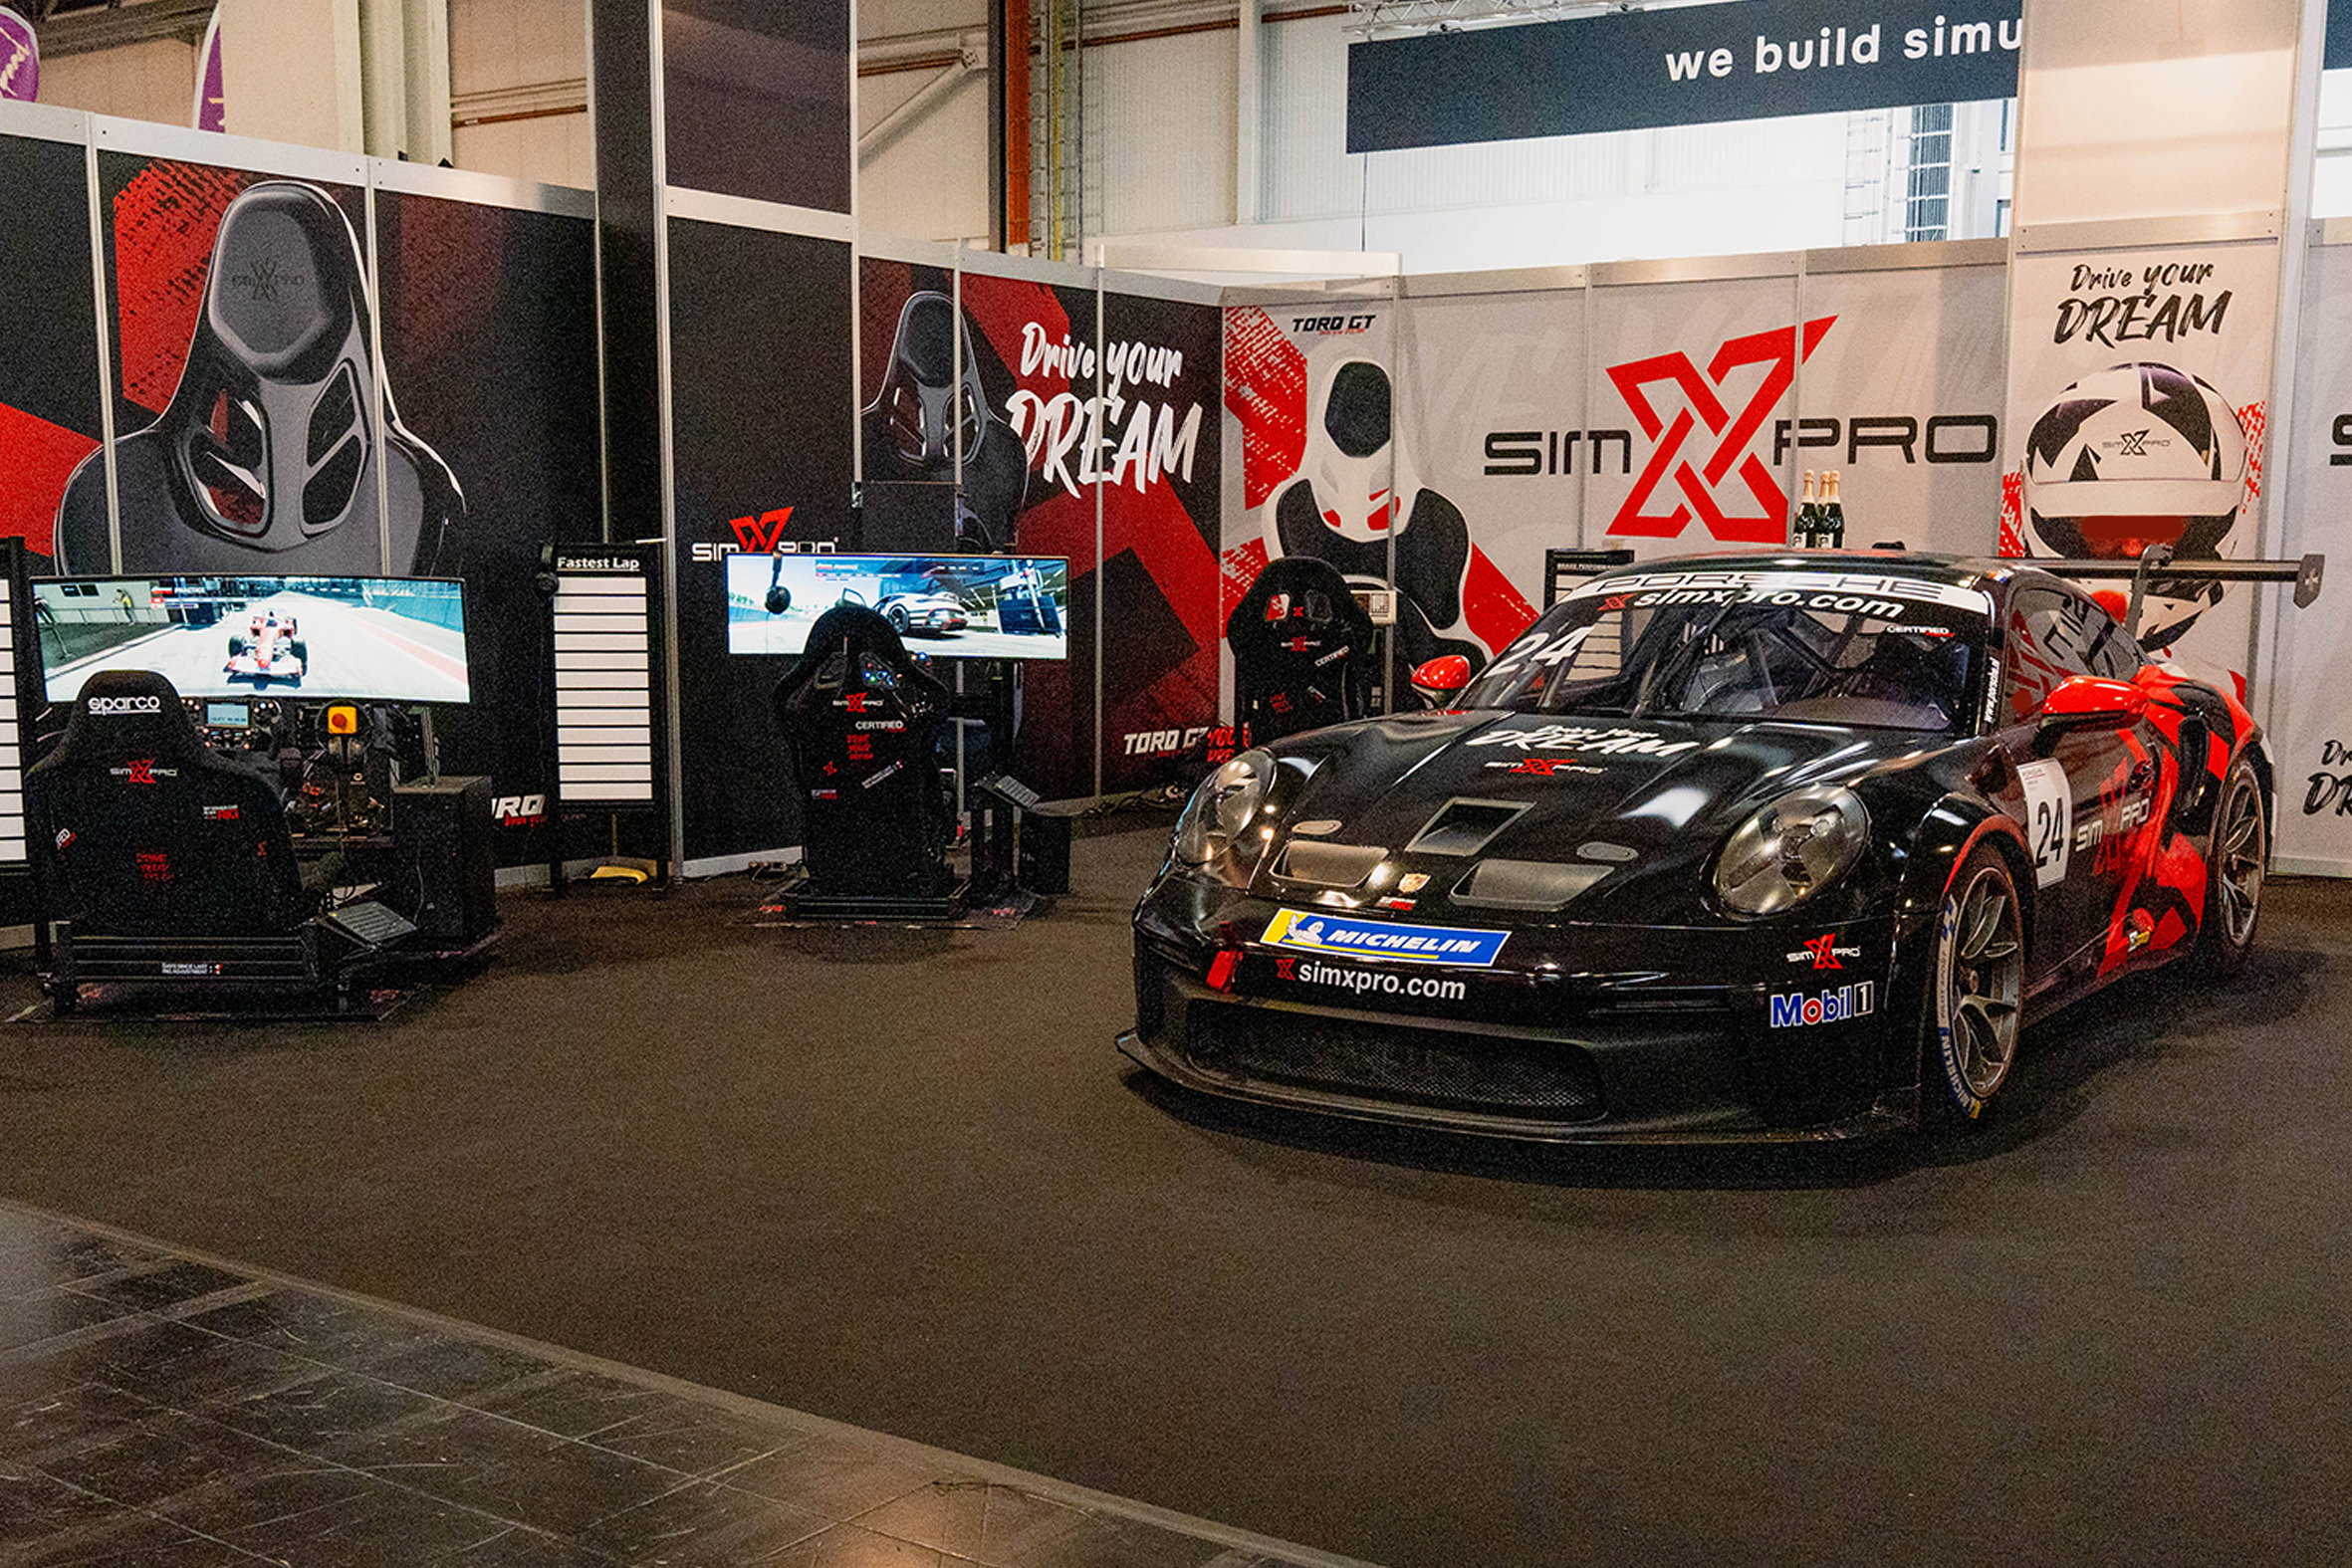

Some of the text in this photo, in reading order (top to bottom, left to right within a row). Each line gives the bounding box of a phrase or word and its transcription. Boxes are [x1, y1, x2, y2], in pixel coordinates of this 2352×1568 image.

[1666, 46, 1735, 82] we
[1755, 23, 1880, 75] build
[2070, 261, 2216, 296] Drive your
[1348, 315, 1377, 330] GT
[2053, 290, 2234, 349] DREAM
[1020, 321, 1184, 400] Drive your
[1005, 389, 1203, 499] DREAM
[558, 556, 640, 572] Fastest Lap
[1633, 587, 1907, 618] simxpro.com
[1483, 625, 1595, 679] 24
[88, 695, 161, 716] sparco
[854, 720, 905, 731] CERTIFIED
[1466, 730, 1702, 758] DREAM
[2035, 797, 2064, 869] 24
[1326, 929, 1482, 953] MICHELIN
[1298, 960, 1466, 1001] simxpro.com
[1769, 985, 1852, 1028] Mobil
[1940, 1034, 1971, 1110] MICHELIN
